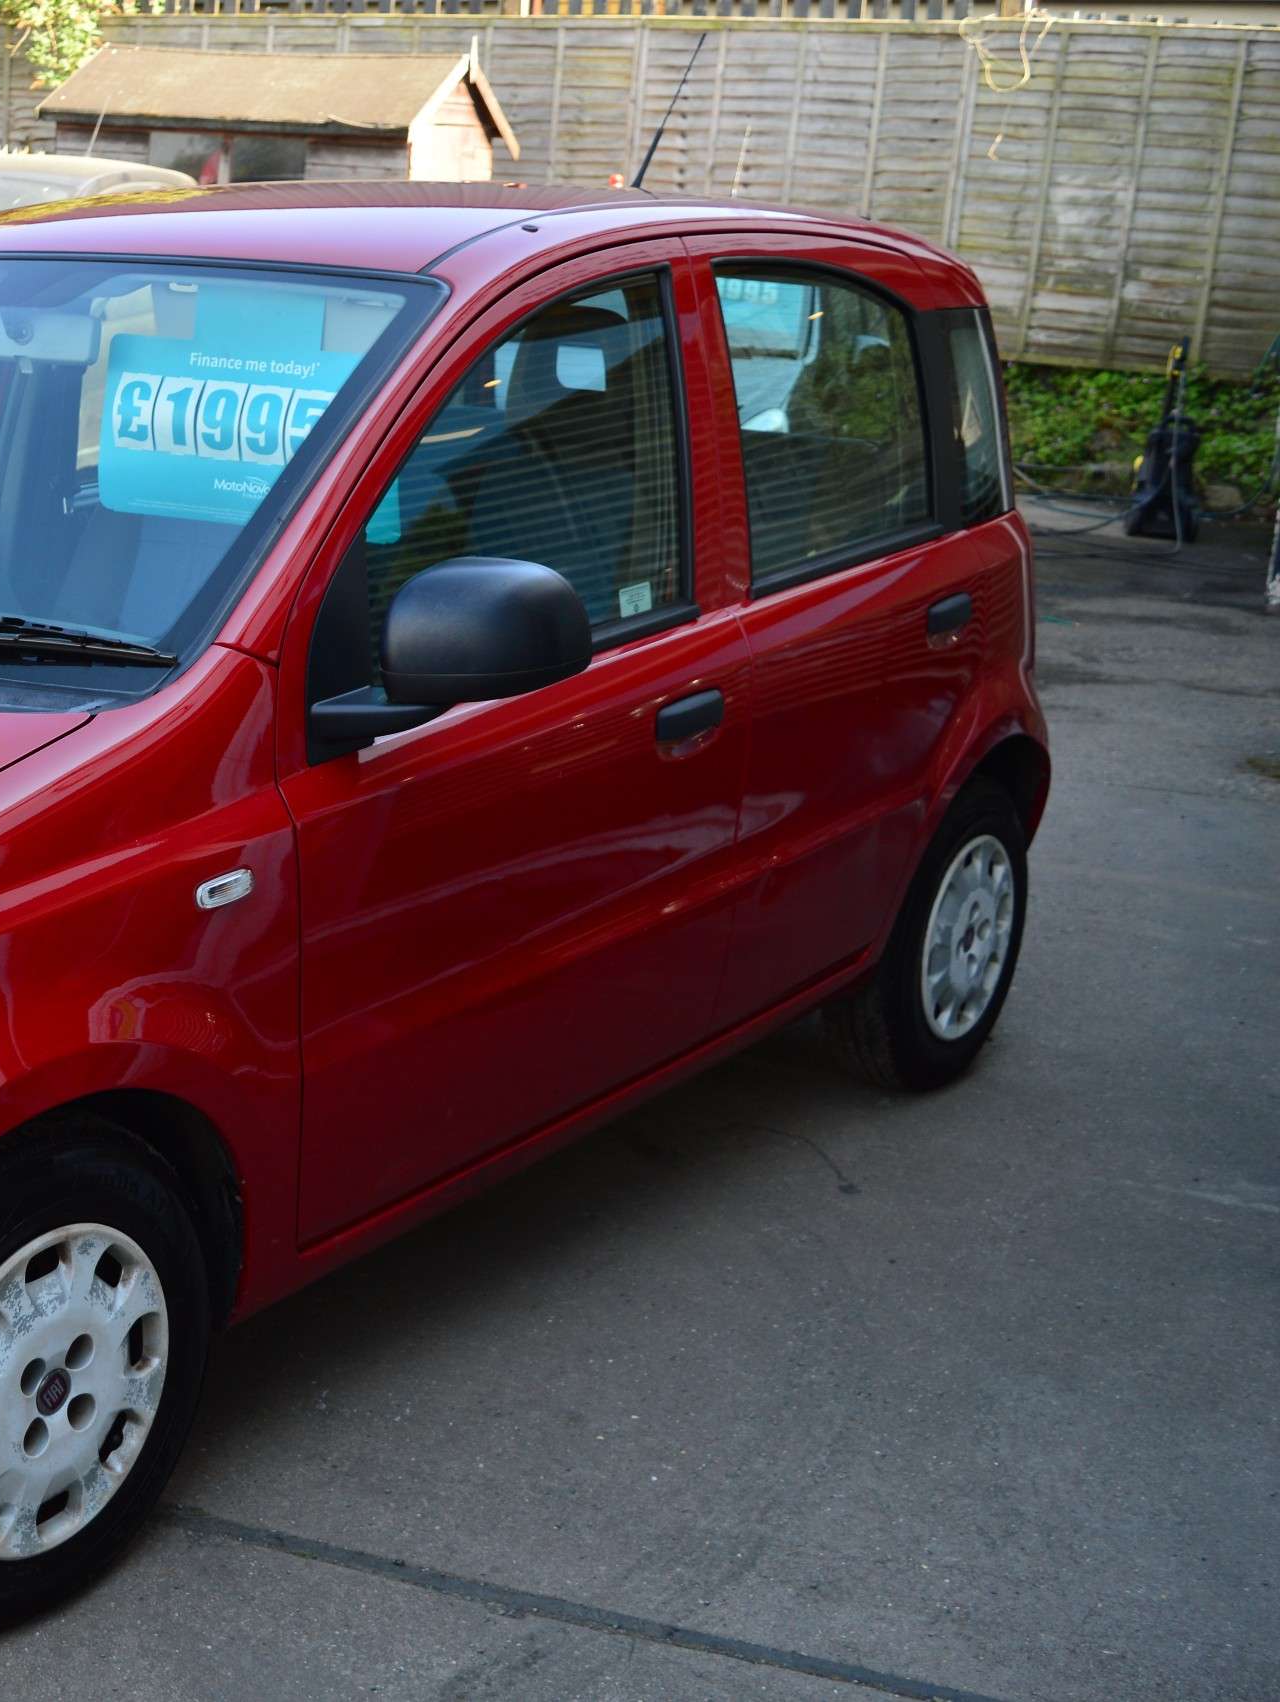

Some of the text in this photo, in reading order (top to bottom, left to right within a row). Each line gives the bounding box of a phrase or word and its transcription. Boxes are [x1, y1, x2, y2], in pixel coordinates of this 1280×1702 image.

[190, 352, 243, 370] Finance
[246, 360, 268, 373] me
[43, 1378, 64, 1408] FIAT
